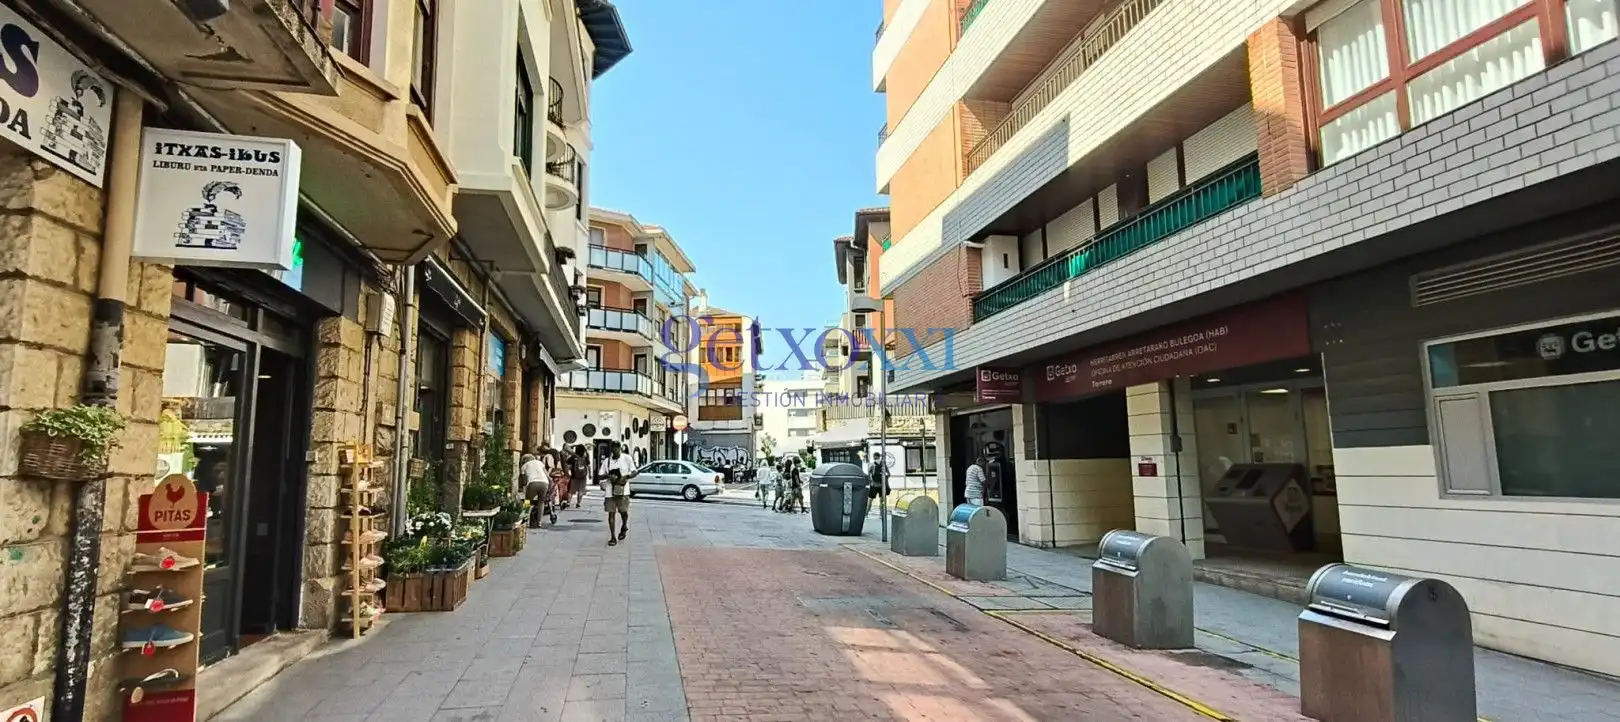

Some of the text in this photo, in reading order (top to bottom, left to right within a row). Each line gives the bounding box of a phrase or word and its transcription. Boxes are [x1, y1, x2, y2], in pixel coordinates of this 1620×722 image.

[153, 160, 191, 171] LIBURU
[210, 164, 279, 177] PAPER-DENDA
[1170, 333, 1204, 348] BULEGOA
[1206, 326, 1229, 340] (HAB)
[1195, 342, 1218, 356] (OAC)
[991, 371, 1019, 381] Getxo
[1055, 363, 1078, 377] Getxo
[154, 509, 191, 523] PITAS
